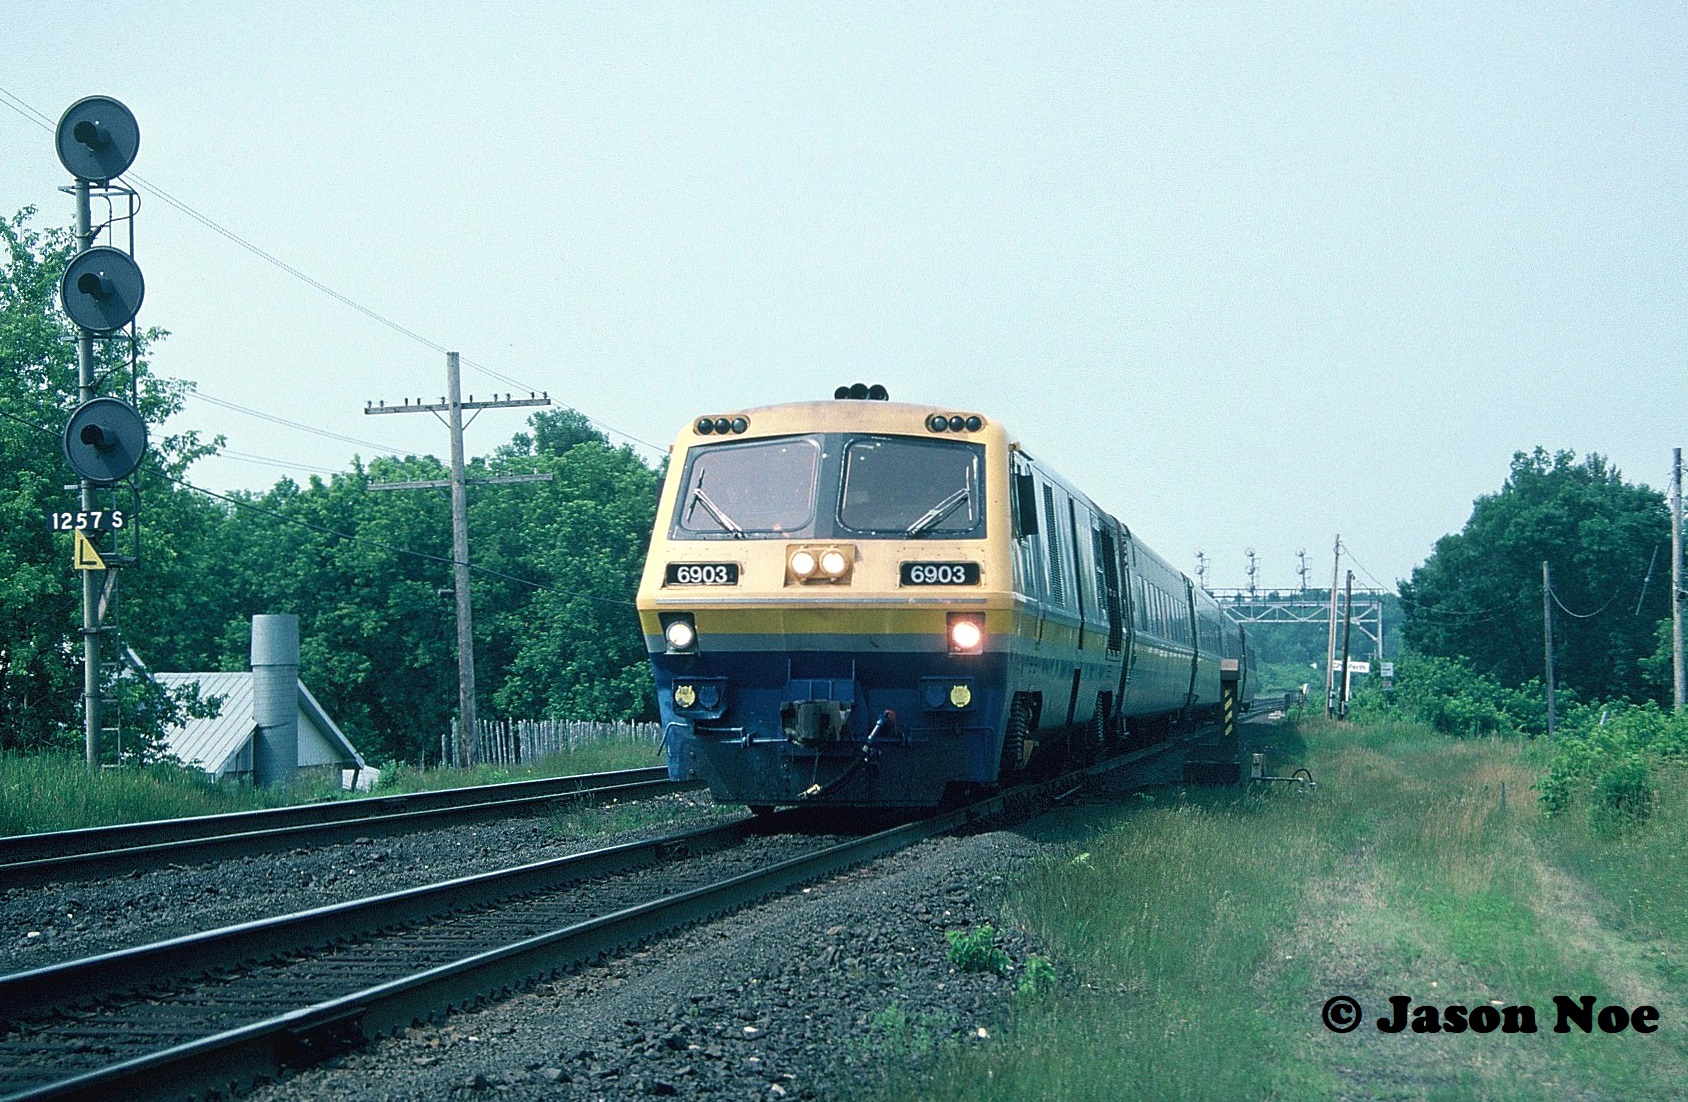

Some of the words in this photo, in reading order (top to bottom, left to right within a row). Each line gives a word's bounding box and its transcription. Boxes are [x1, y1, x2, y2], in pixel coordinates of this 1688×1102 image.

[52, 512, 103, 530] 1257
[111, 511, 123, 528] S
[79, 539, 97, 565] L
[677, 565, 728, 583] 6903
[910, 565, 966, 583] 6903
